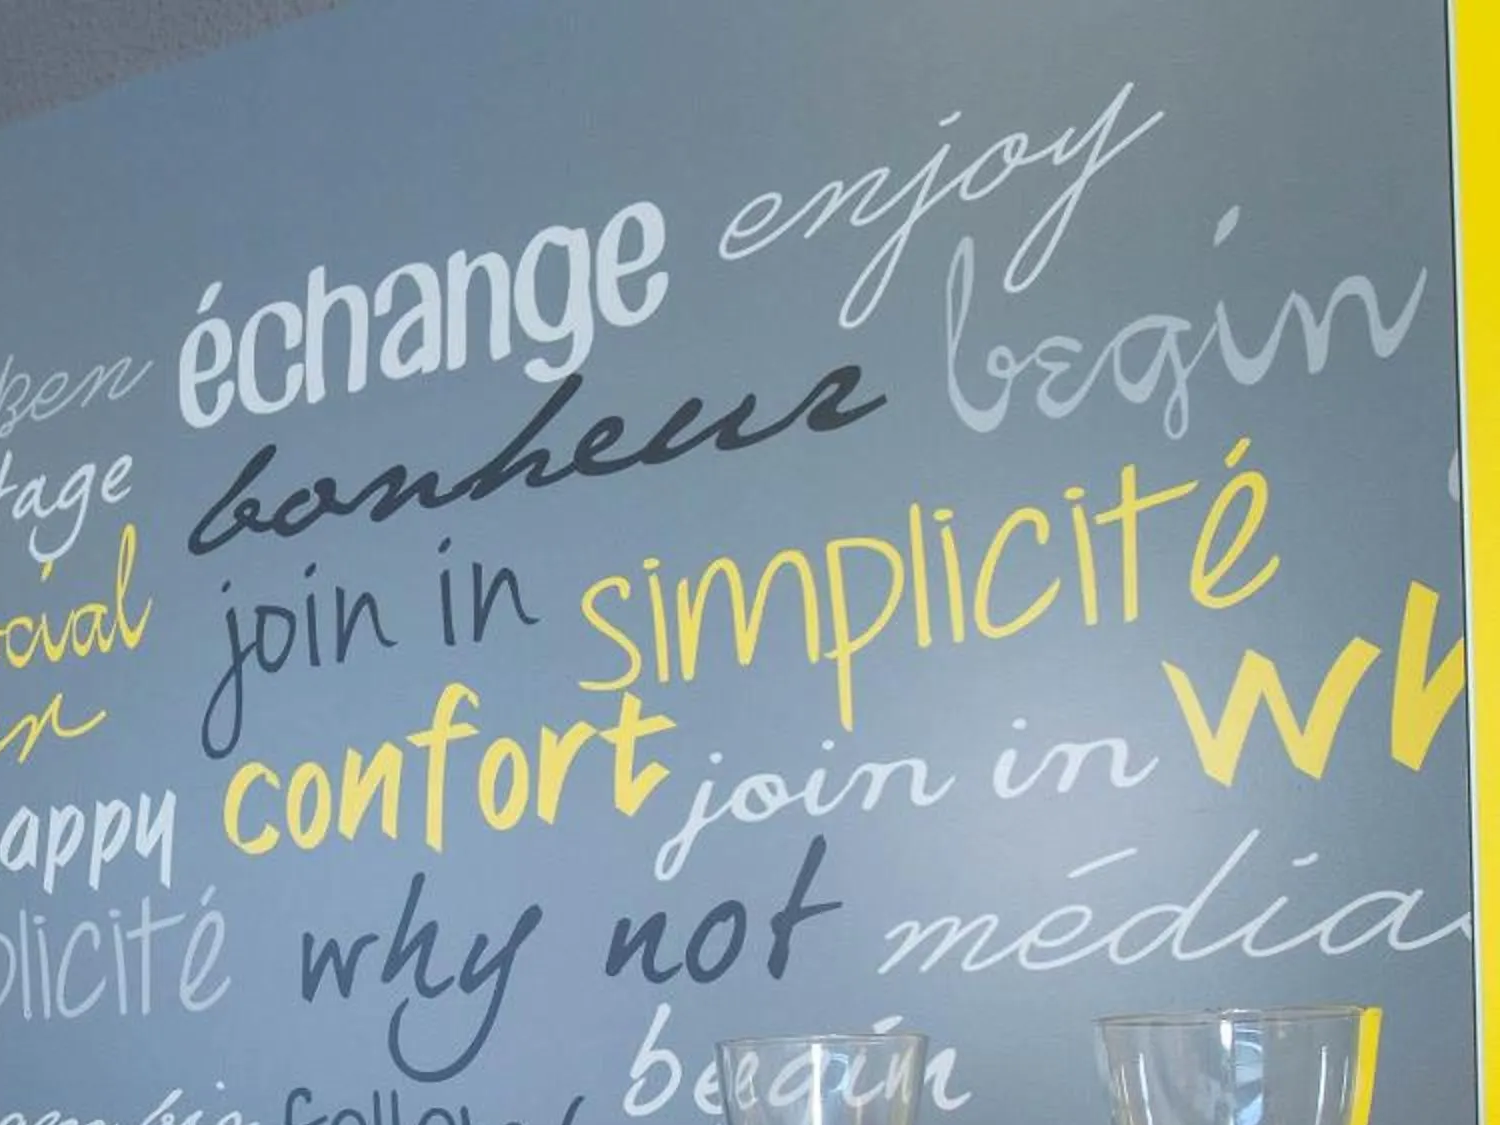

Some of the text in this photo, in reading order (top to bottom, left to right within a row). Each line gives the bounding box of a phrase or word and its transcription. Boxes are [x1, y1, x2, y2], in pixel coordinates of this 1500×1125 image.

[178, 196, 670, 428] échange
[719, 82, 1165, 329] enjoy
[946, 205, 1428, 440] begin
[187, 365, 887, 556] bonheur
[201, 536, 540, 760] join in
[579, 437, 1280, 731] simplicité
[224, 682, 678, 856] confort
[654, 716, 1160, 882] join in
[301, 835, 843, 1084] why not
